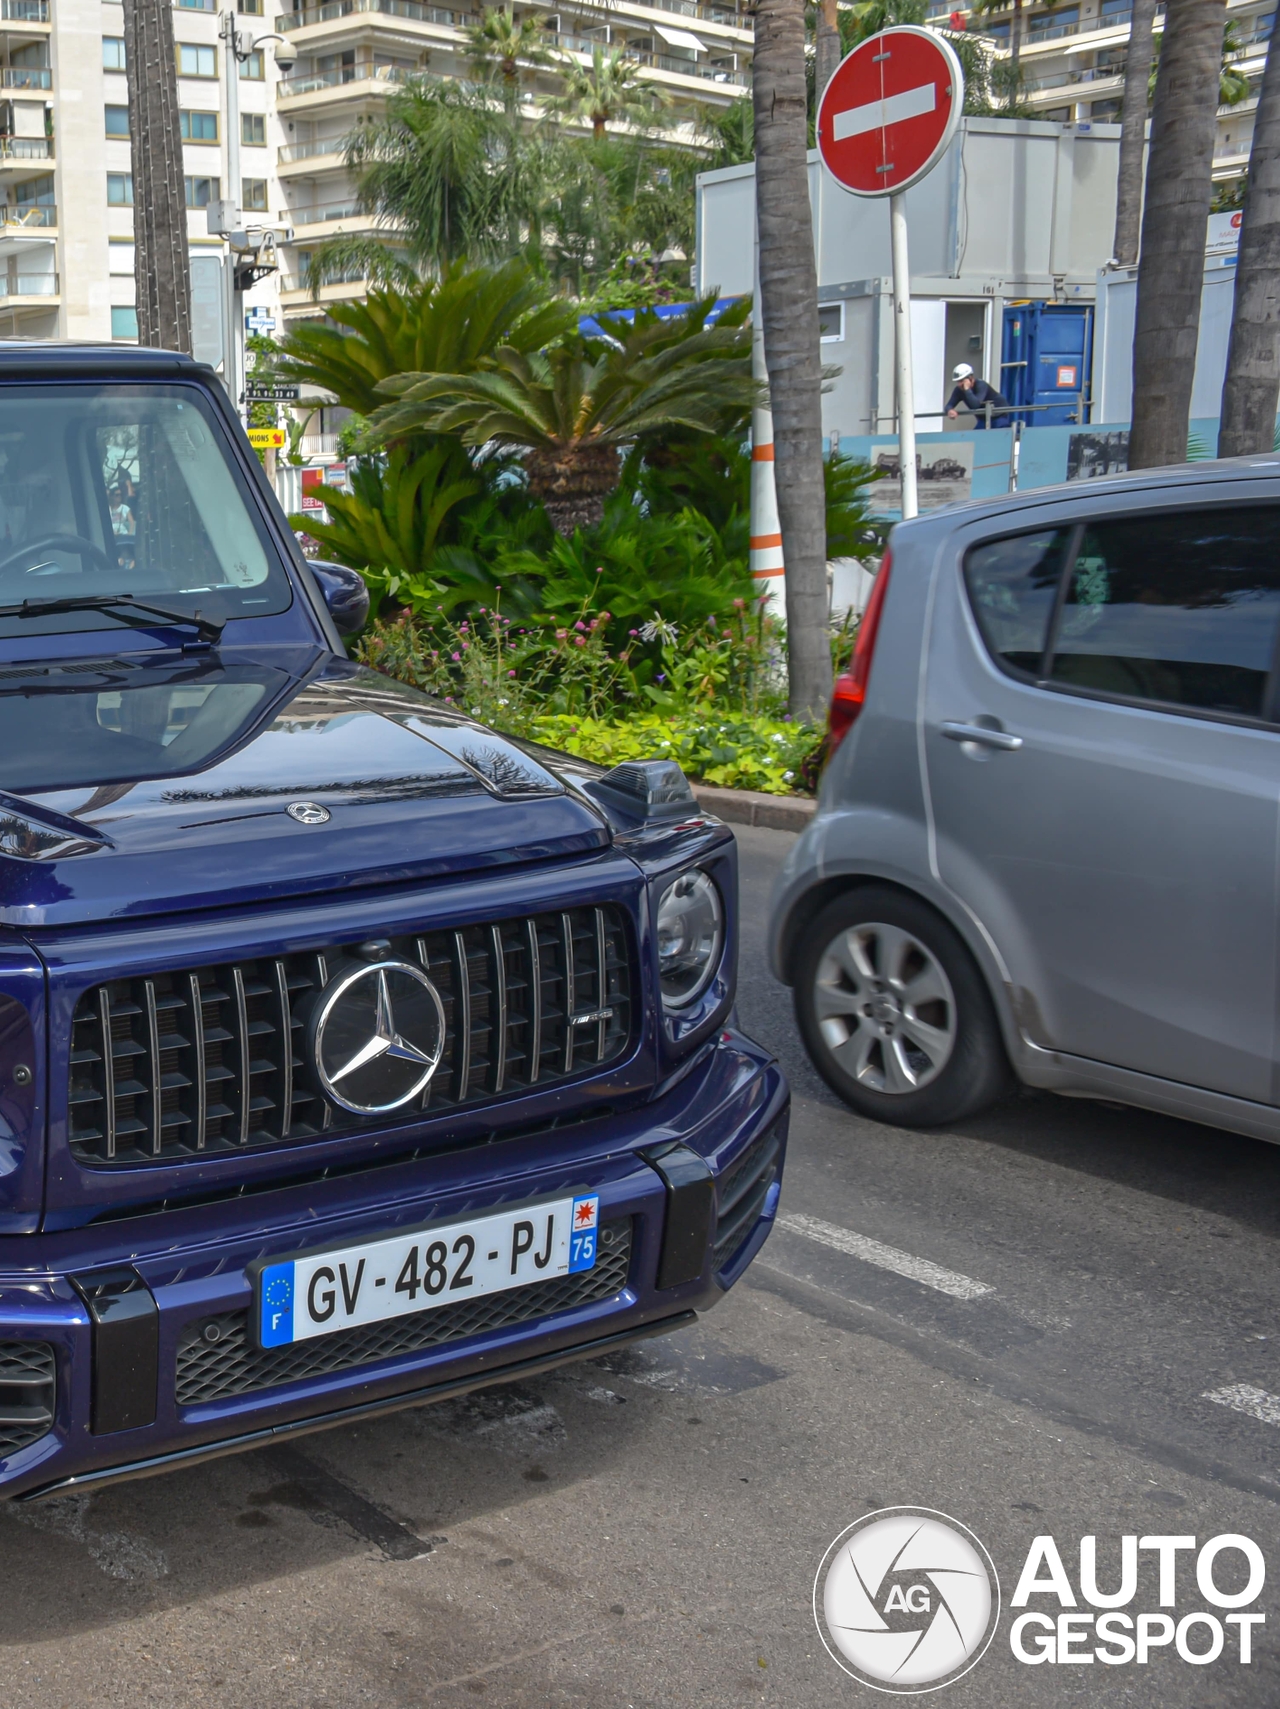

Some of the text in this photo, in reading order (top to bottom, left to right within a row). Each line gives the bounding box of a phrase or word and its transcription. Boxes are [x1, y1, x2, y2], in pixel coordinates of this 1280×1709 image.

[573, 1236, 594, 1262] 75
[306, 1213, 554, 1324] GV-482-PJ
[271, 1312, 283, 1331] F
